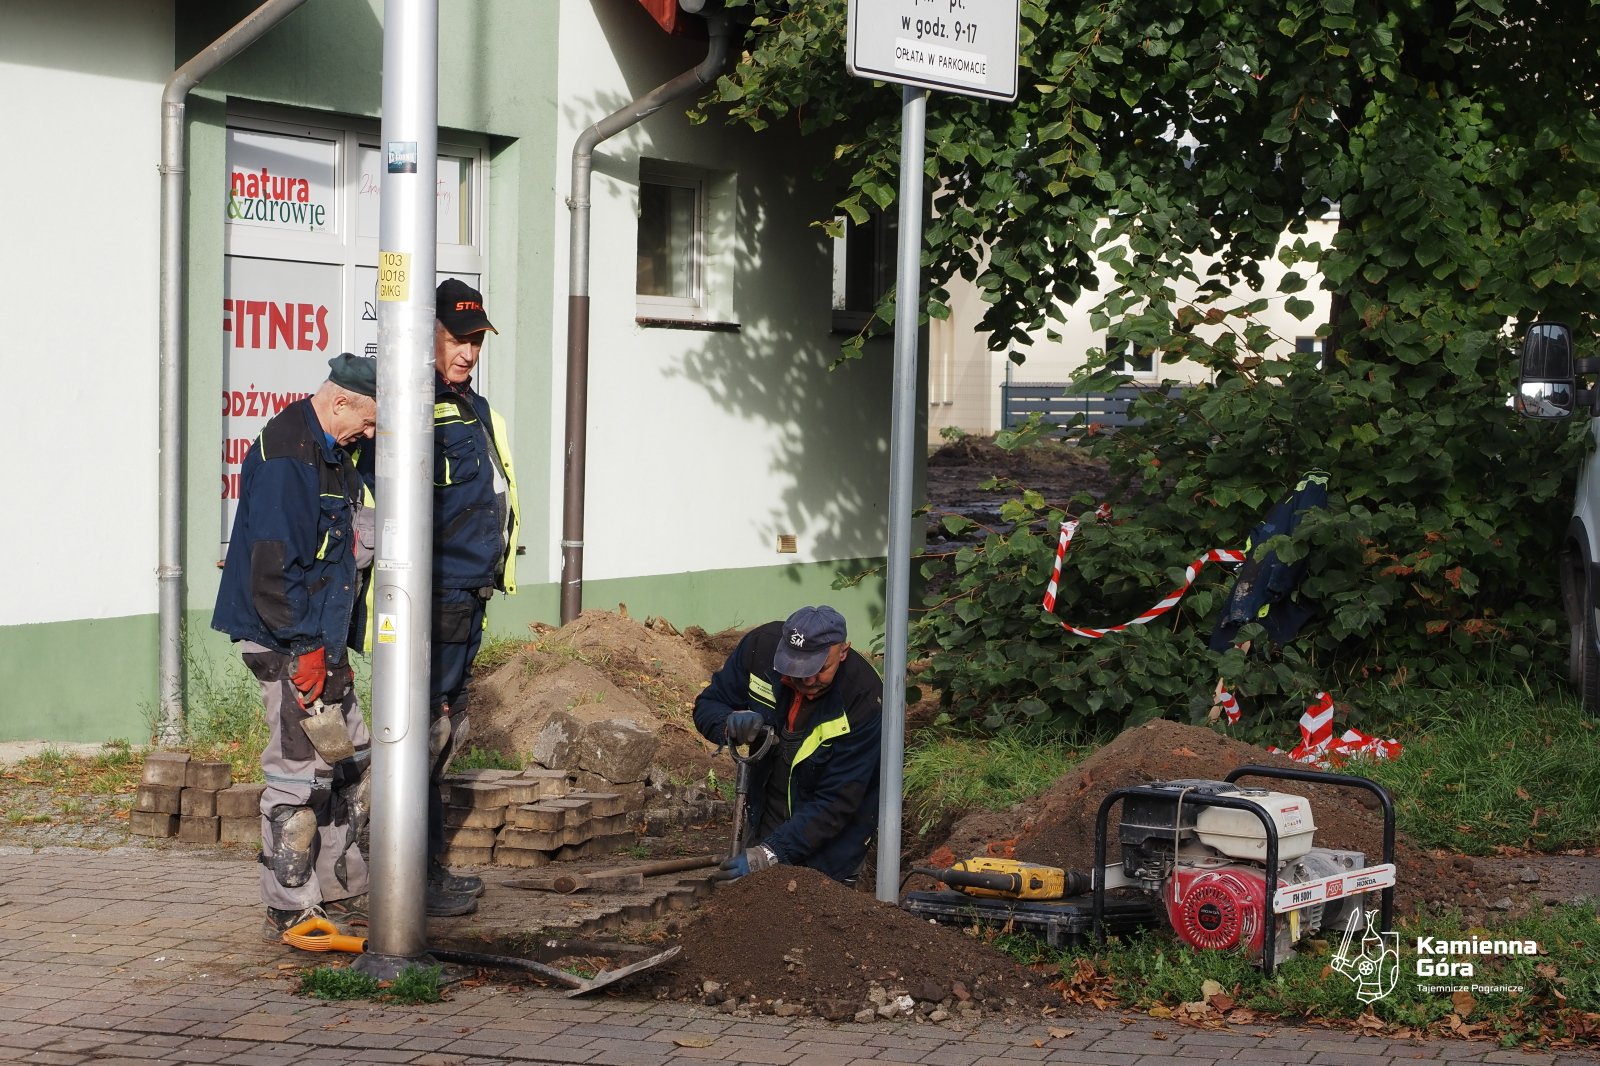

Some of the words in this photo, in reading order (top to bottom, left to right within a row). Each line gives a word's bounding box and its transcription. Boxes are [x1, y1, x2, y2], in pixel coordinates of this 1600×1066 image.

[901, 15, 911, 31] w
[916, 17, 949, 39] godz.
[954, 20, 977, 44] 9-17
[895, 46, 924, 63] OPŁATA
[928, 53, 935, 66] W
[938, 55, 987, 75] PARKOMACIE
[231, 168, 309, 203] natura
[384, 253, 403, 267] 103
[380, 284, 401, 297] GMKG
[1356, 878, 1376, 888] HONDA
